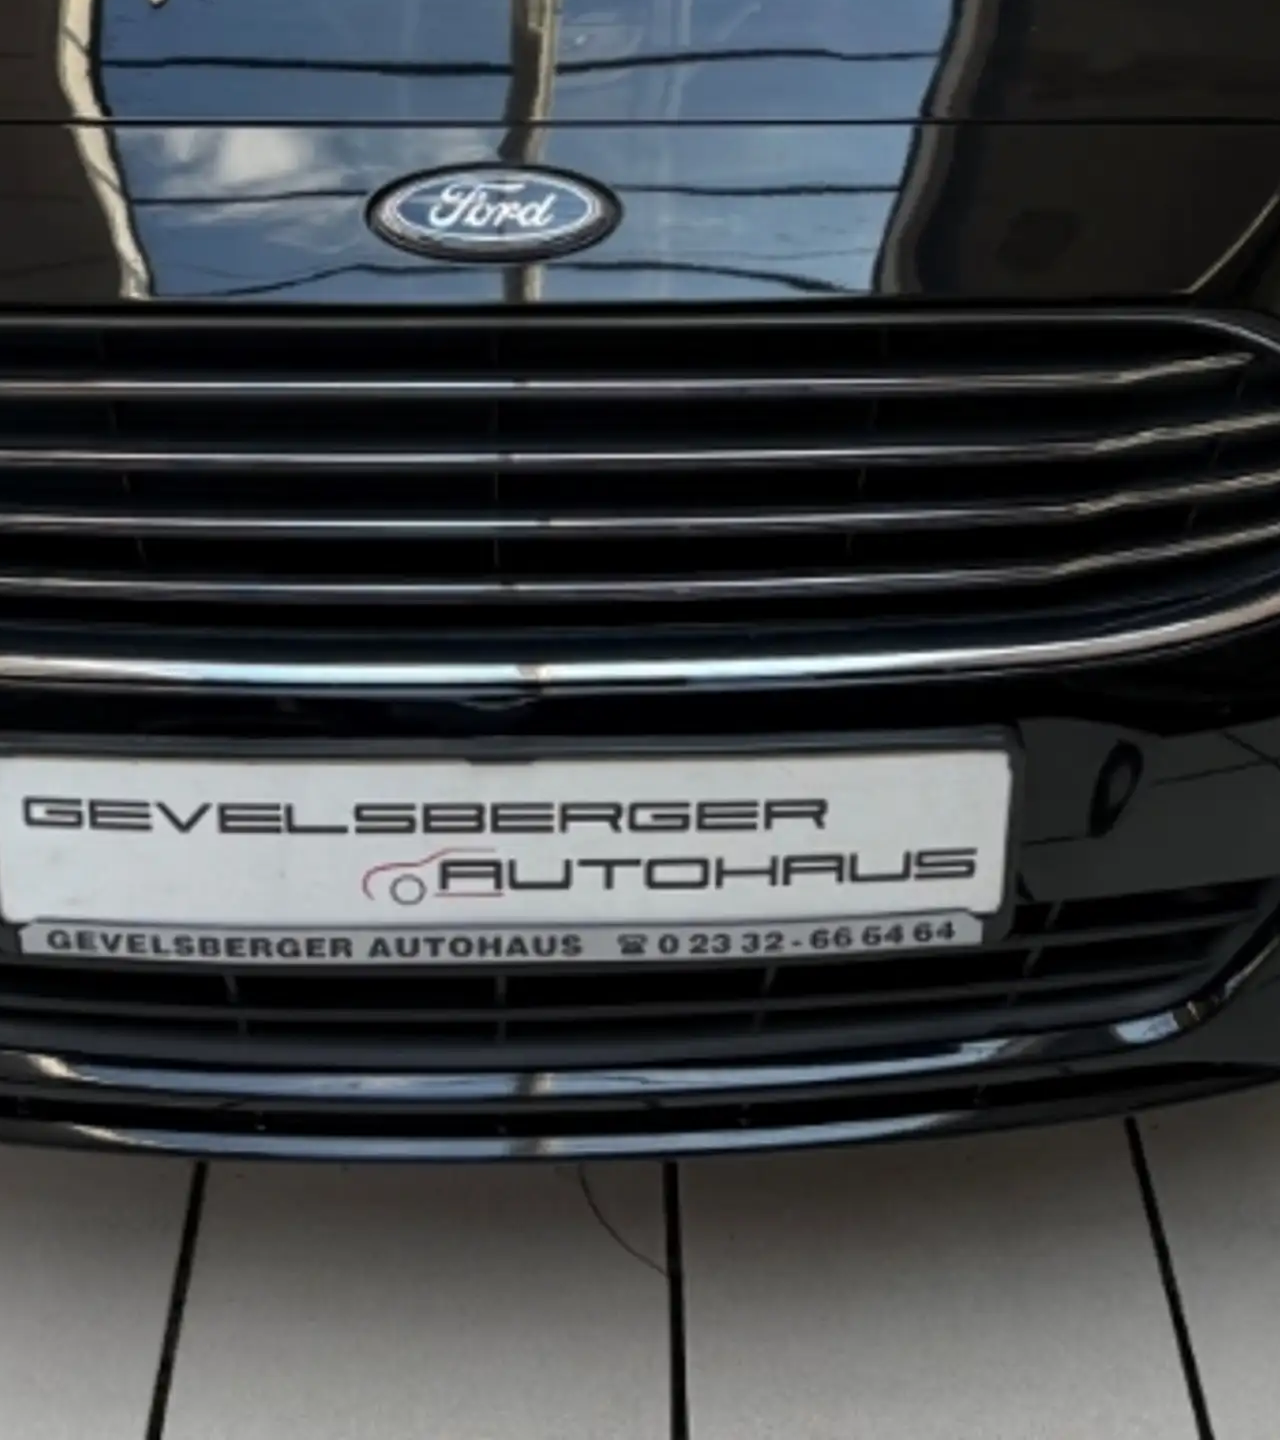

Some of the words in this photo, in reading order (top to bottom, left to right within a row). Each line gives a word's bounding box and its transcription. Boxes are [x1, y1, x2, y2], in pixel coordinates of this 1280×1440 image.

[428, 183, 558, 228] Ford
[23, 796, 828, 835] GEVELSBERGER
[440, 847, 977, 891] AUTOHAUS
[46, 928, 353, 959] GEVELSBERGER
[368, 934, 583, 959] AUTOHAUS
